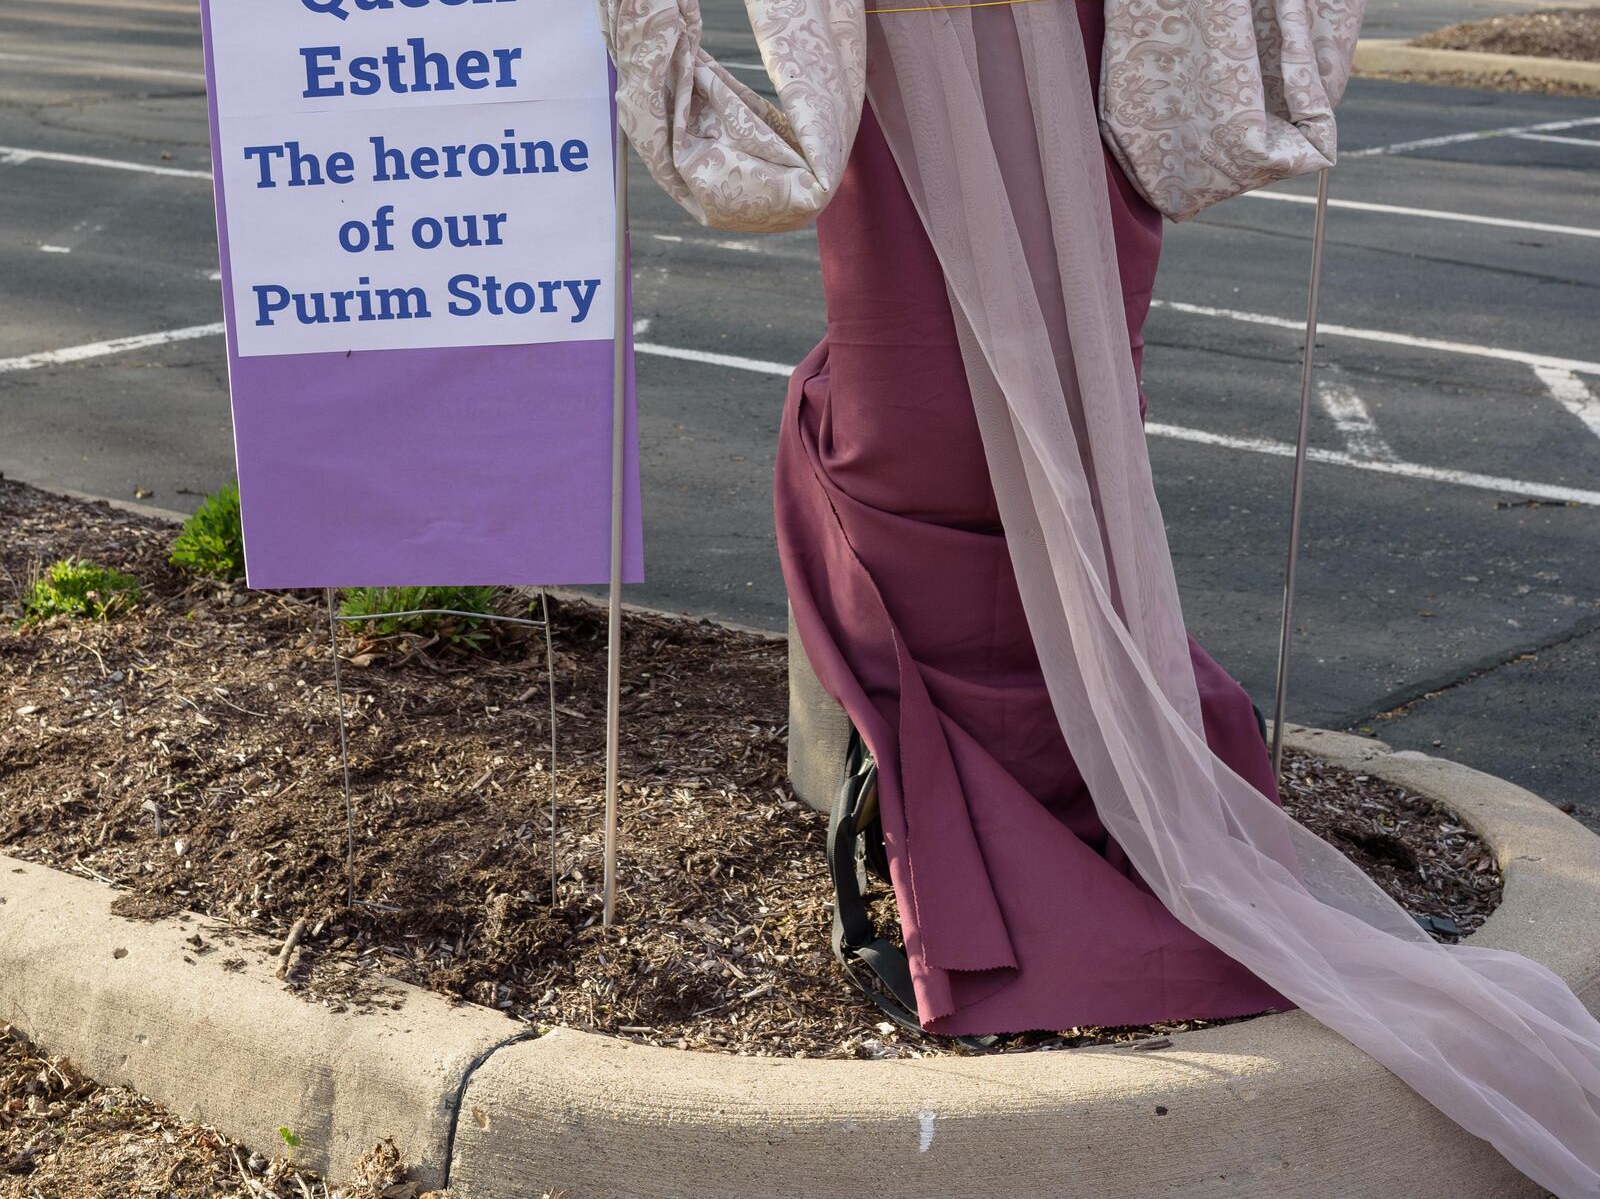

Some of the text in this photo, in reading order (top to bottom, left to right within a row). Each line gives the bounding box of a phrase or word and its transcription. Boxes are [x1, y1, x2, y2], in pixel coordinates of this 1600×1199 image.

[299, 37, 524, 99] Esther
[243, 128, 590, 189] The heroine
[338, 204, 508, 253] of our
[251, 273, 602, 327] Purim Story
